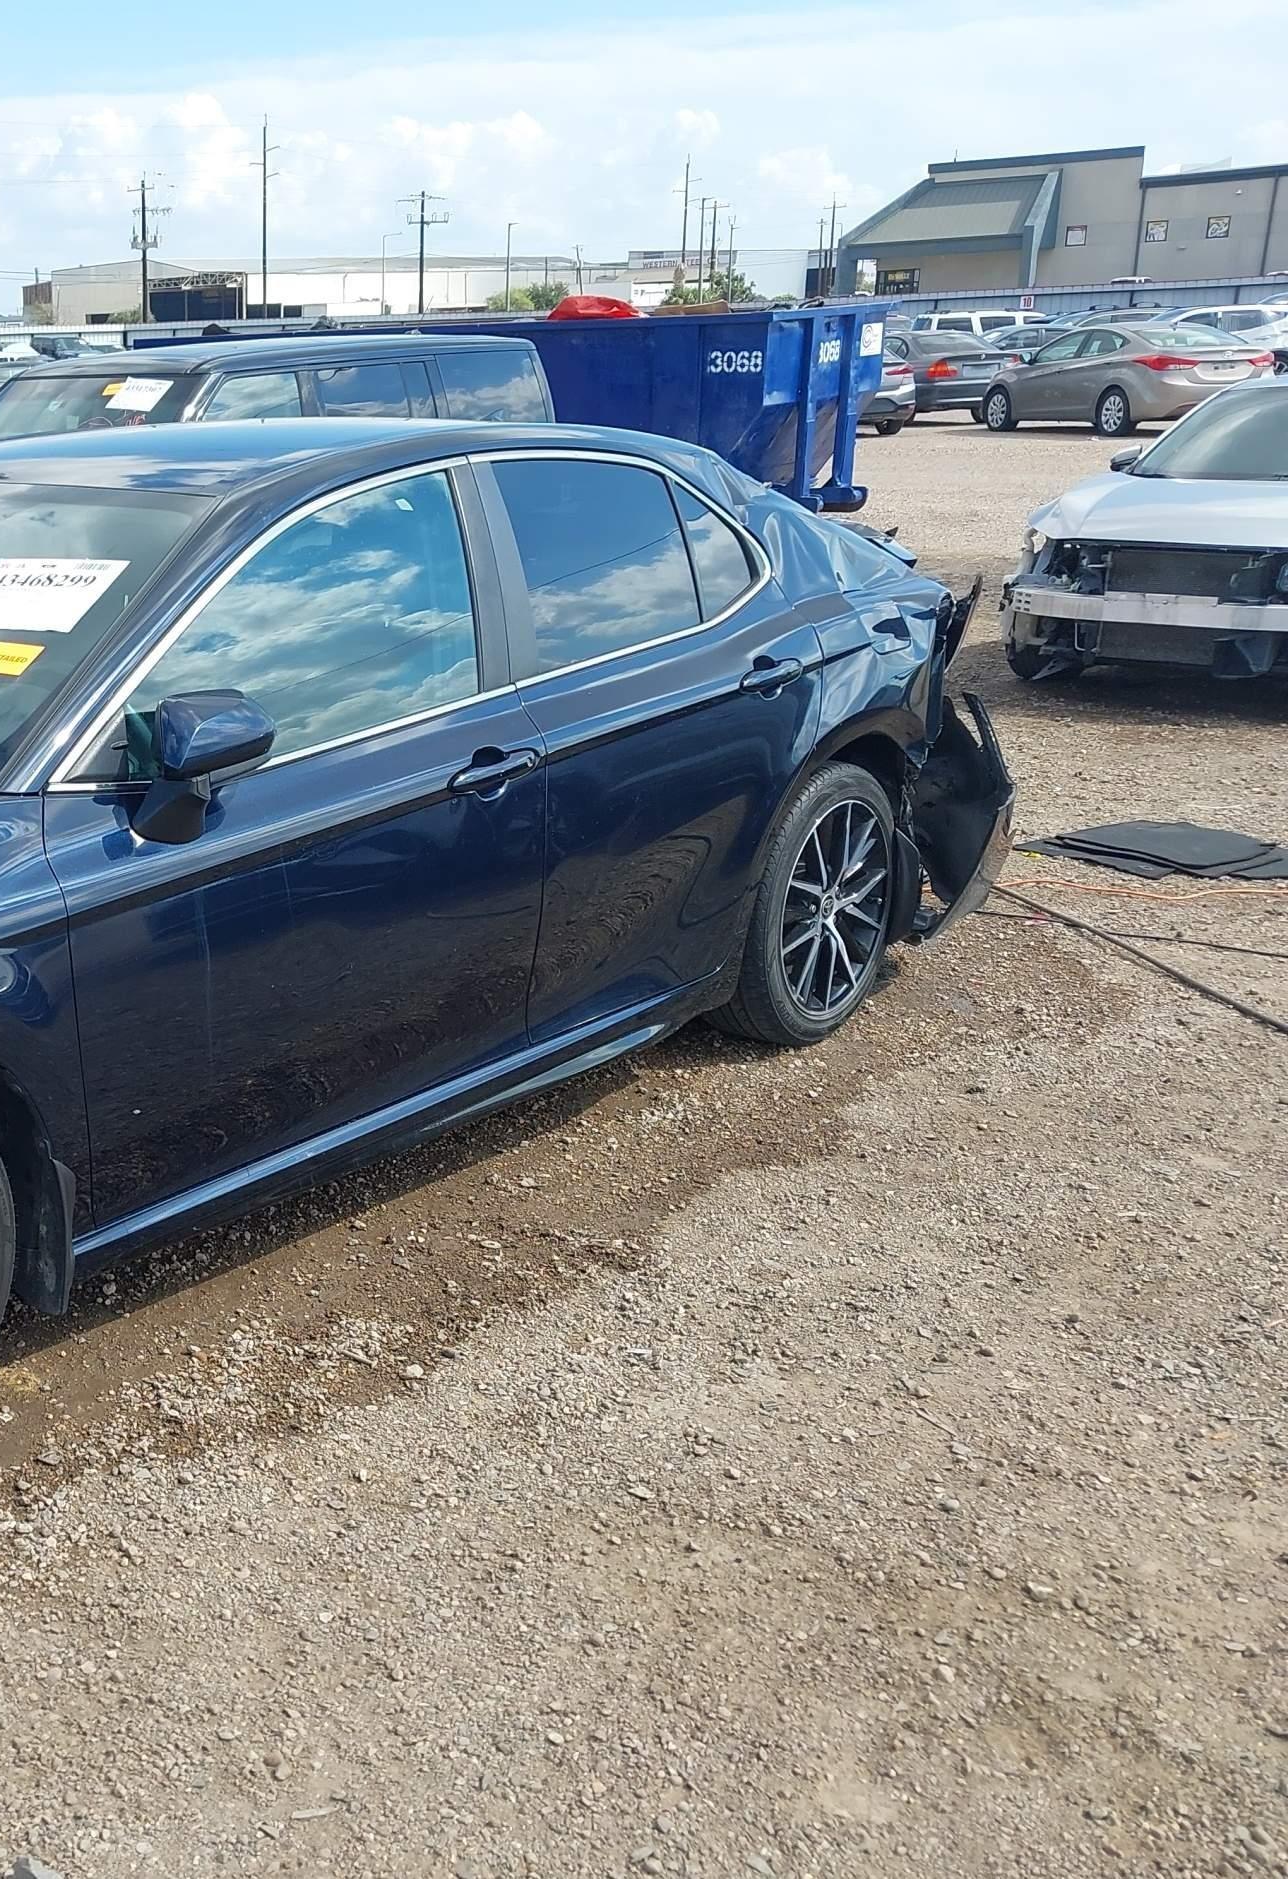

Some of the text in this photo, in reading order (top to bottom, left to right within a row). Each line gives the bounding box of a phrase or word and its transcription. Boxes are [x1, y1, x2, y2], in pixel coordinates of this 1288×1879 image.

[643, 259, 677, 269] WESTERN
[1023, 297, 1032, 307] 10
[711, 351, 762, 373] 3068
